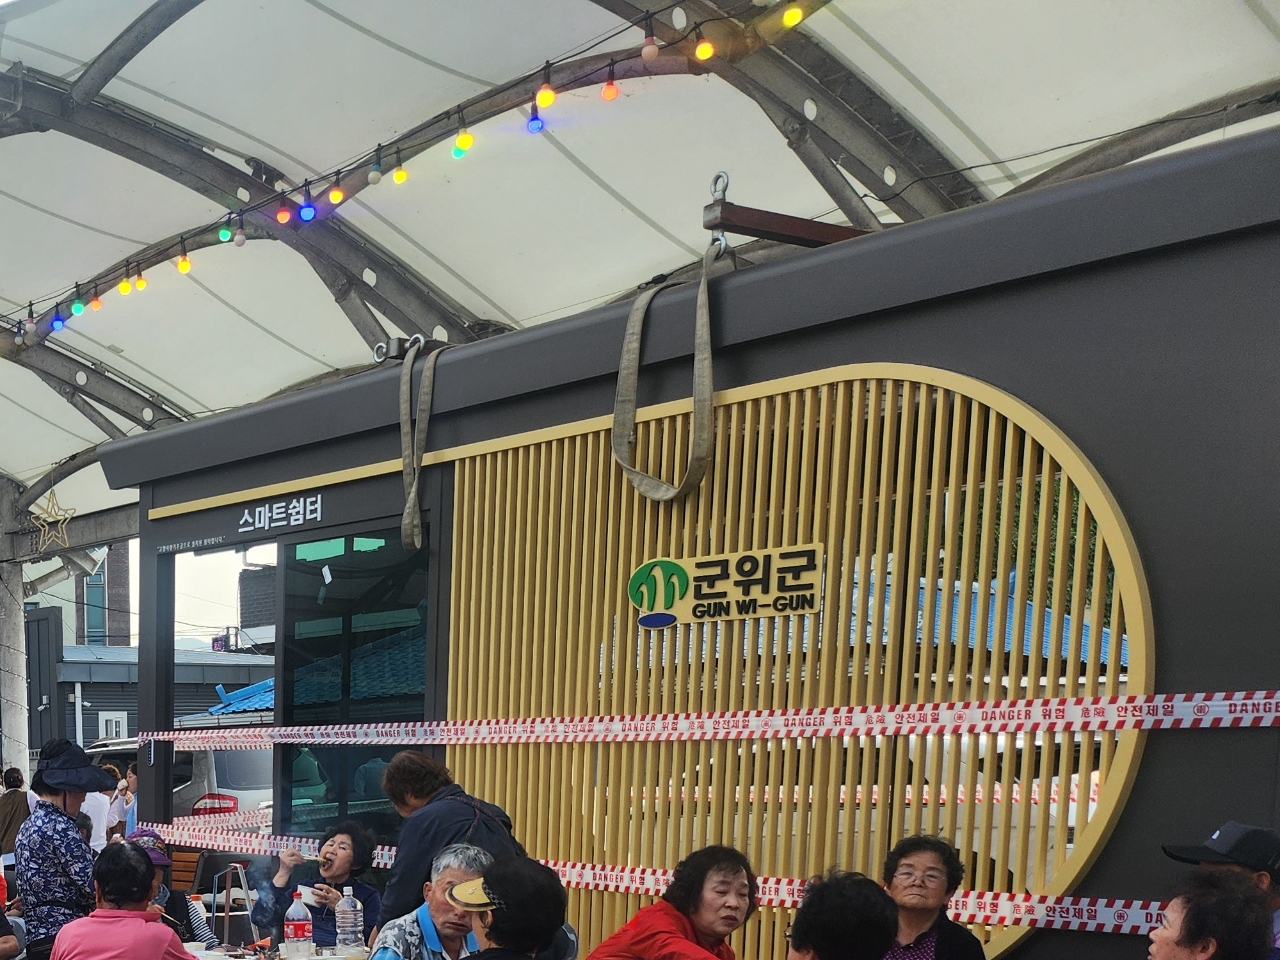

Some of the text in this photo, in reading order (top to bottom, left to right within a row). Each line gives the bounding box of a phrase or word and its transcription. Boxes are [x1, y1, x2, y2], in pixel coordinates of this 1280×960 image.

[238, 494, 322, 533] 스마트쉼터
[693, 549, 817, 600] 군위군
[692, 593, 815, 619] GUN WI-GUN
[376, 729, 400, 738] DANGER
[404, 728, 417, 738] 위험
[439, 727, 466, 736] 안전제일
[488, 725, 518, 735] DANGER
[521, 724, 536, 735] 위험
[563, 722, 595, 733] 안전제일
[621, 722, 656, 732] DANGER
[661, 721, 678, 732] 위험
[712, 718, 750, 730] 안전제일
[783, 716, 825, 728] DANGER
[832, 715, 853, 727] 위험
[894, 711, 941, 725] 안전제일
[981, 709, 1032, 722] DANGER
[1041, 707, 1066, 720] 위험
[1081, 706, 1106, 718] 危險
[1116, 703, 1175, 718] 안전제일
[1228, 701, 1280, 714] DANGE
[592, 872, 624, 883] DANGER
[630, 875, 645, 886] 위험
[786, 887, 805, 899] 위험
[947, 900, 969, 911] GER
[976, 901, 1000, 914] 위험
[1045, 905, 1098, 921] 안전제일
